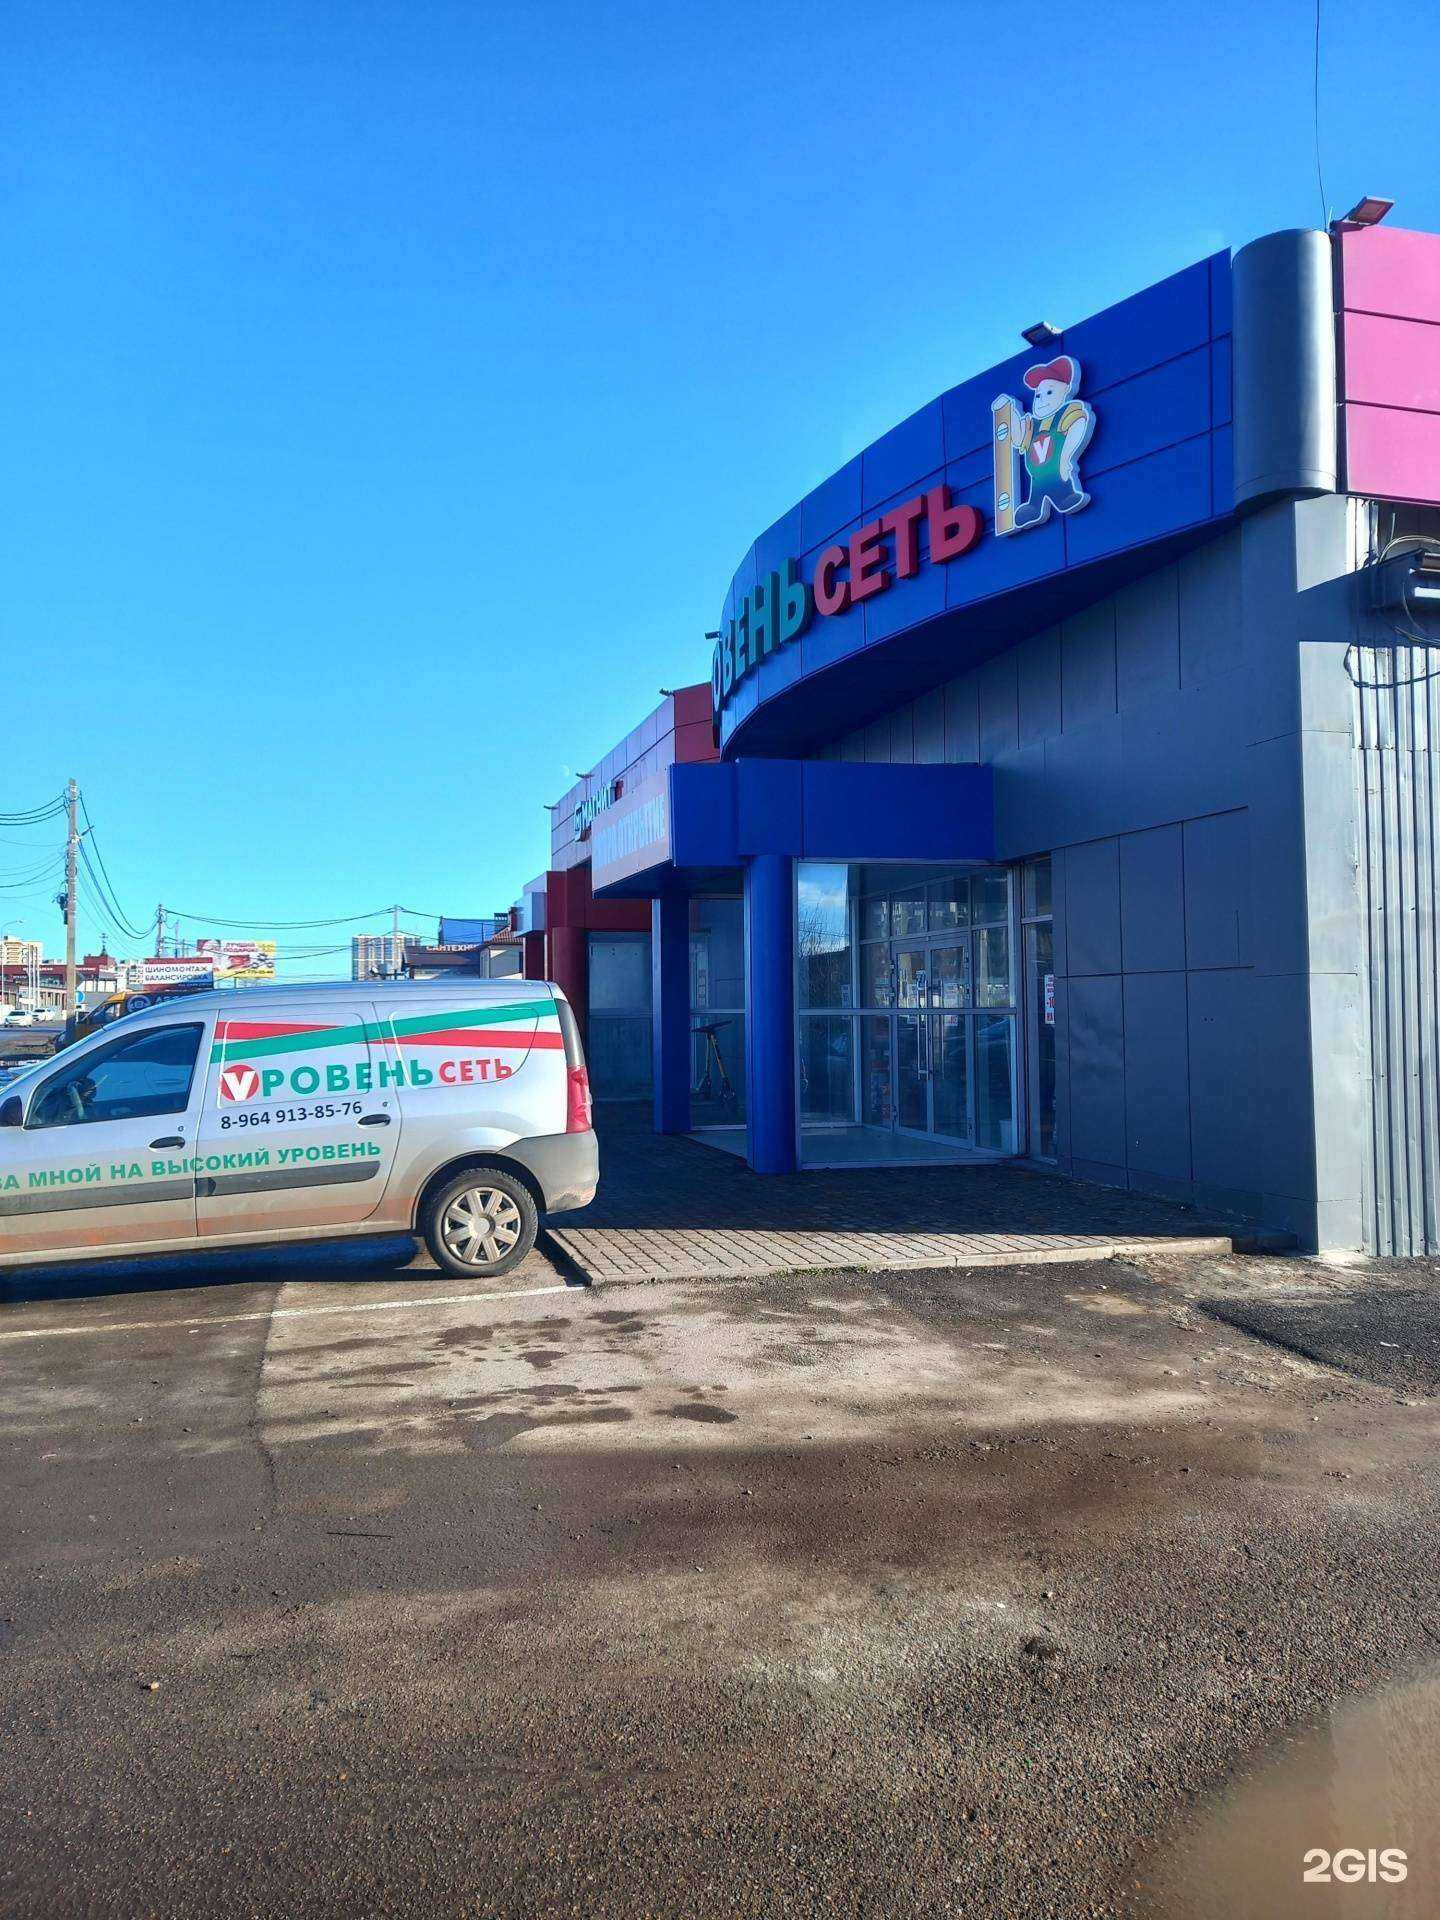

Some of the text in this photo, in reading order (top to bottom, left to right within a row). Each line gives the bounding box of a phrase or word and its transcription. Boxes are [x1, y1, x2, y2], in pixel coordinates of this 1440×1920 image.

[813, 485, 983, 616] СЕТЬ
[145, 965, 208, 973] ШИНОМОНТАЖ
[145, 973, 209, 981] БАЛАНСИРОВКА
[439, 1058, 513, 1084] СЕТЬ
[221, 1101, 363, 1130] 8-964 913-85-76
[0, 1142, 381, 1190] А МНОЙ НА ВЫСОКИЙ УРОВЕНЬ
